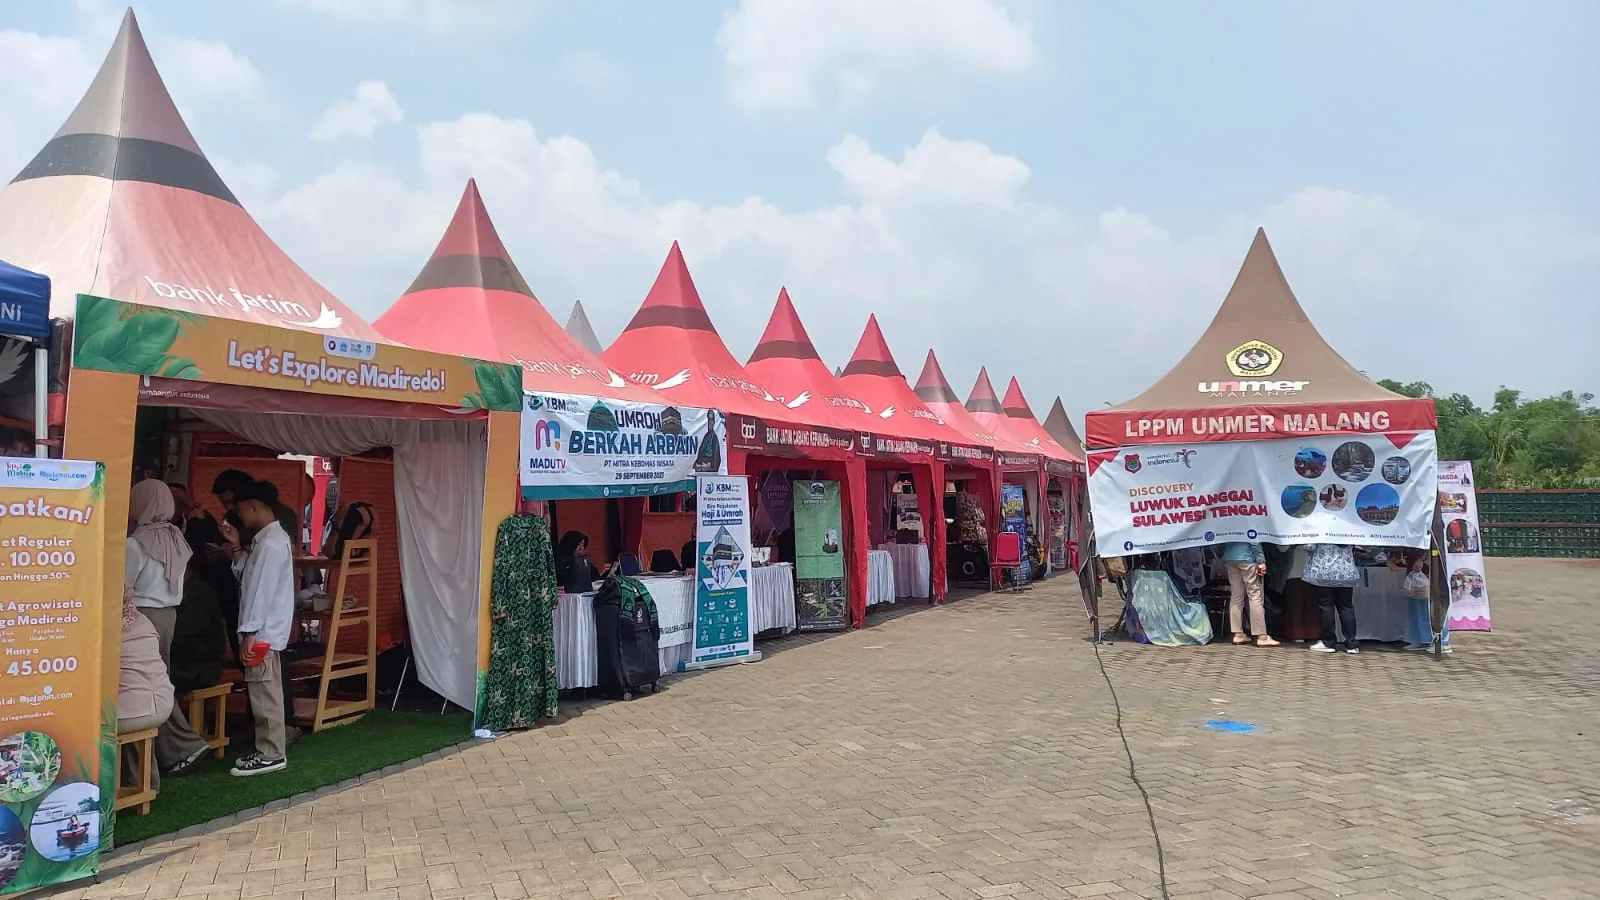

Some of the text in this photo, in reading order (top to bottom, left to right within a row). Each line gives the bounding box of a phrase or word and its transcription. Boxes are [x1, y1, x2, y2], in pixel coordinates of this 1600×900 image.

[144, 275, 312, 318] bank jatim
[228, 341, 446, 392] Let's Explore Madiredo!
[1198, 380, 1310, 393] unmer
[1210, 390, 1297, 398] MALANG
[615, 410, 662, 431] UMROH
[1126, 410, 1390, 437] LPPM UNMER MALANG
[568, 430, 698, 456] BERKAH ARBAIN
[766, 428, 780, 444] BANK
[604, 460, 612, 468] PT
[623, 472, 654, 480] SEPTEMBER
[716, 483, 731, 493] KBM
[1129, 482, 1194, 497] DISCOVERY
[1130, 490, 1253, 514] LUWUK BANGGAI
[702, 509, 715, 519] Haji
[721, 509, 744, 518] Umrah
[1132, 504, 1268, 528] SULAWESI TENGAH
[19, 536, 73, 550] Reguler
[9, 551, 76, 567] 10.000
[14, 572, 48, 582] Hingga
[50, 571, 71, 580] 50%
[7, 599, 83, 613] Agrowisata
[17, 612, 79, 626] Madiredo
[6, 647, 39, 656] Hanya
[7, 657, 78, 676] 45.000
